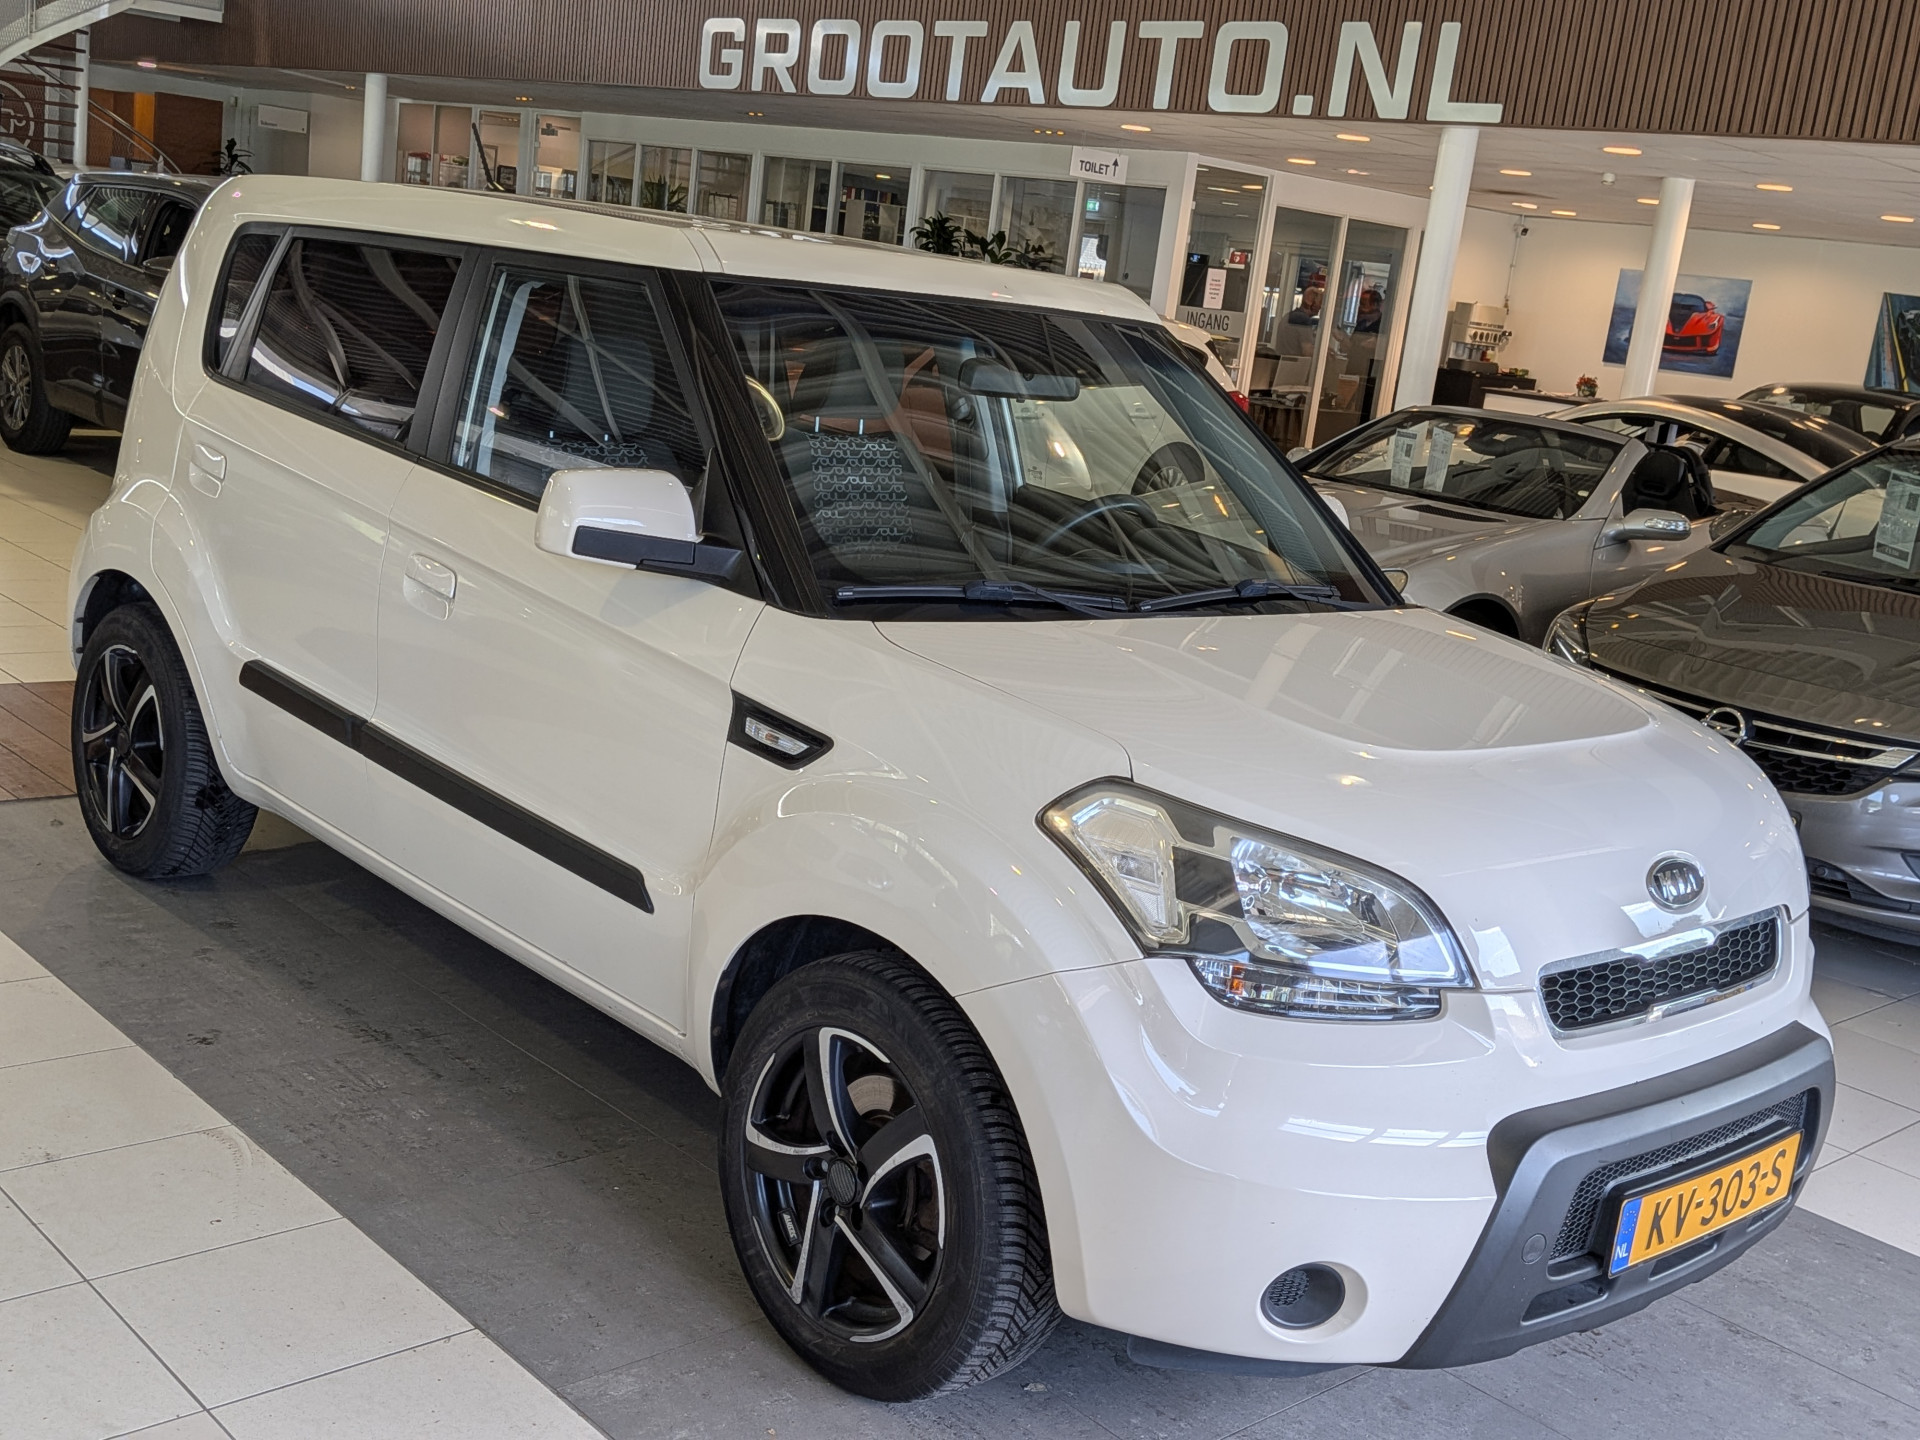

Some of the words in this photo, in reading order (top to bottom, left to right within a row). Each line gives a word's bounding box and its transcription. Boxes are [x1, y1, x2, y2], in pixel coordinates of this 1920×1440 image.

[699, 17, 1503, 123] GROOTAUTO.NL
[1080, 159, 1110, 176] TOILET
[1186, 310, 1230, 331] INGANG
[1646, 1148, 1787, 1251] KV-303-S
[1614, 1243, 1629, 1260] NL
